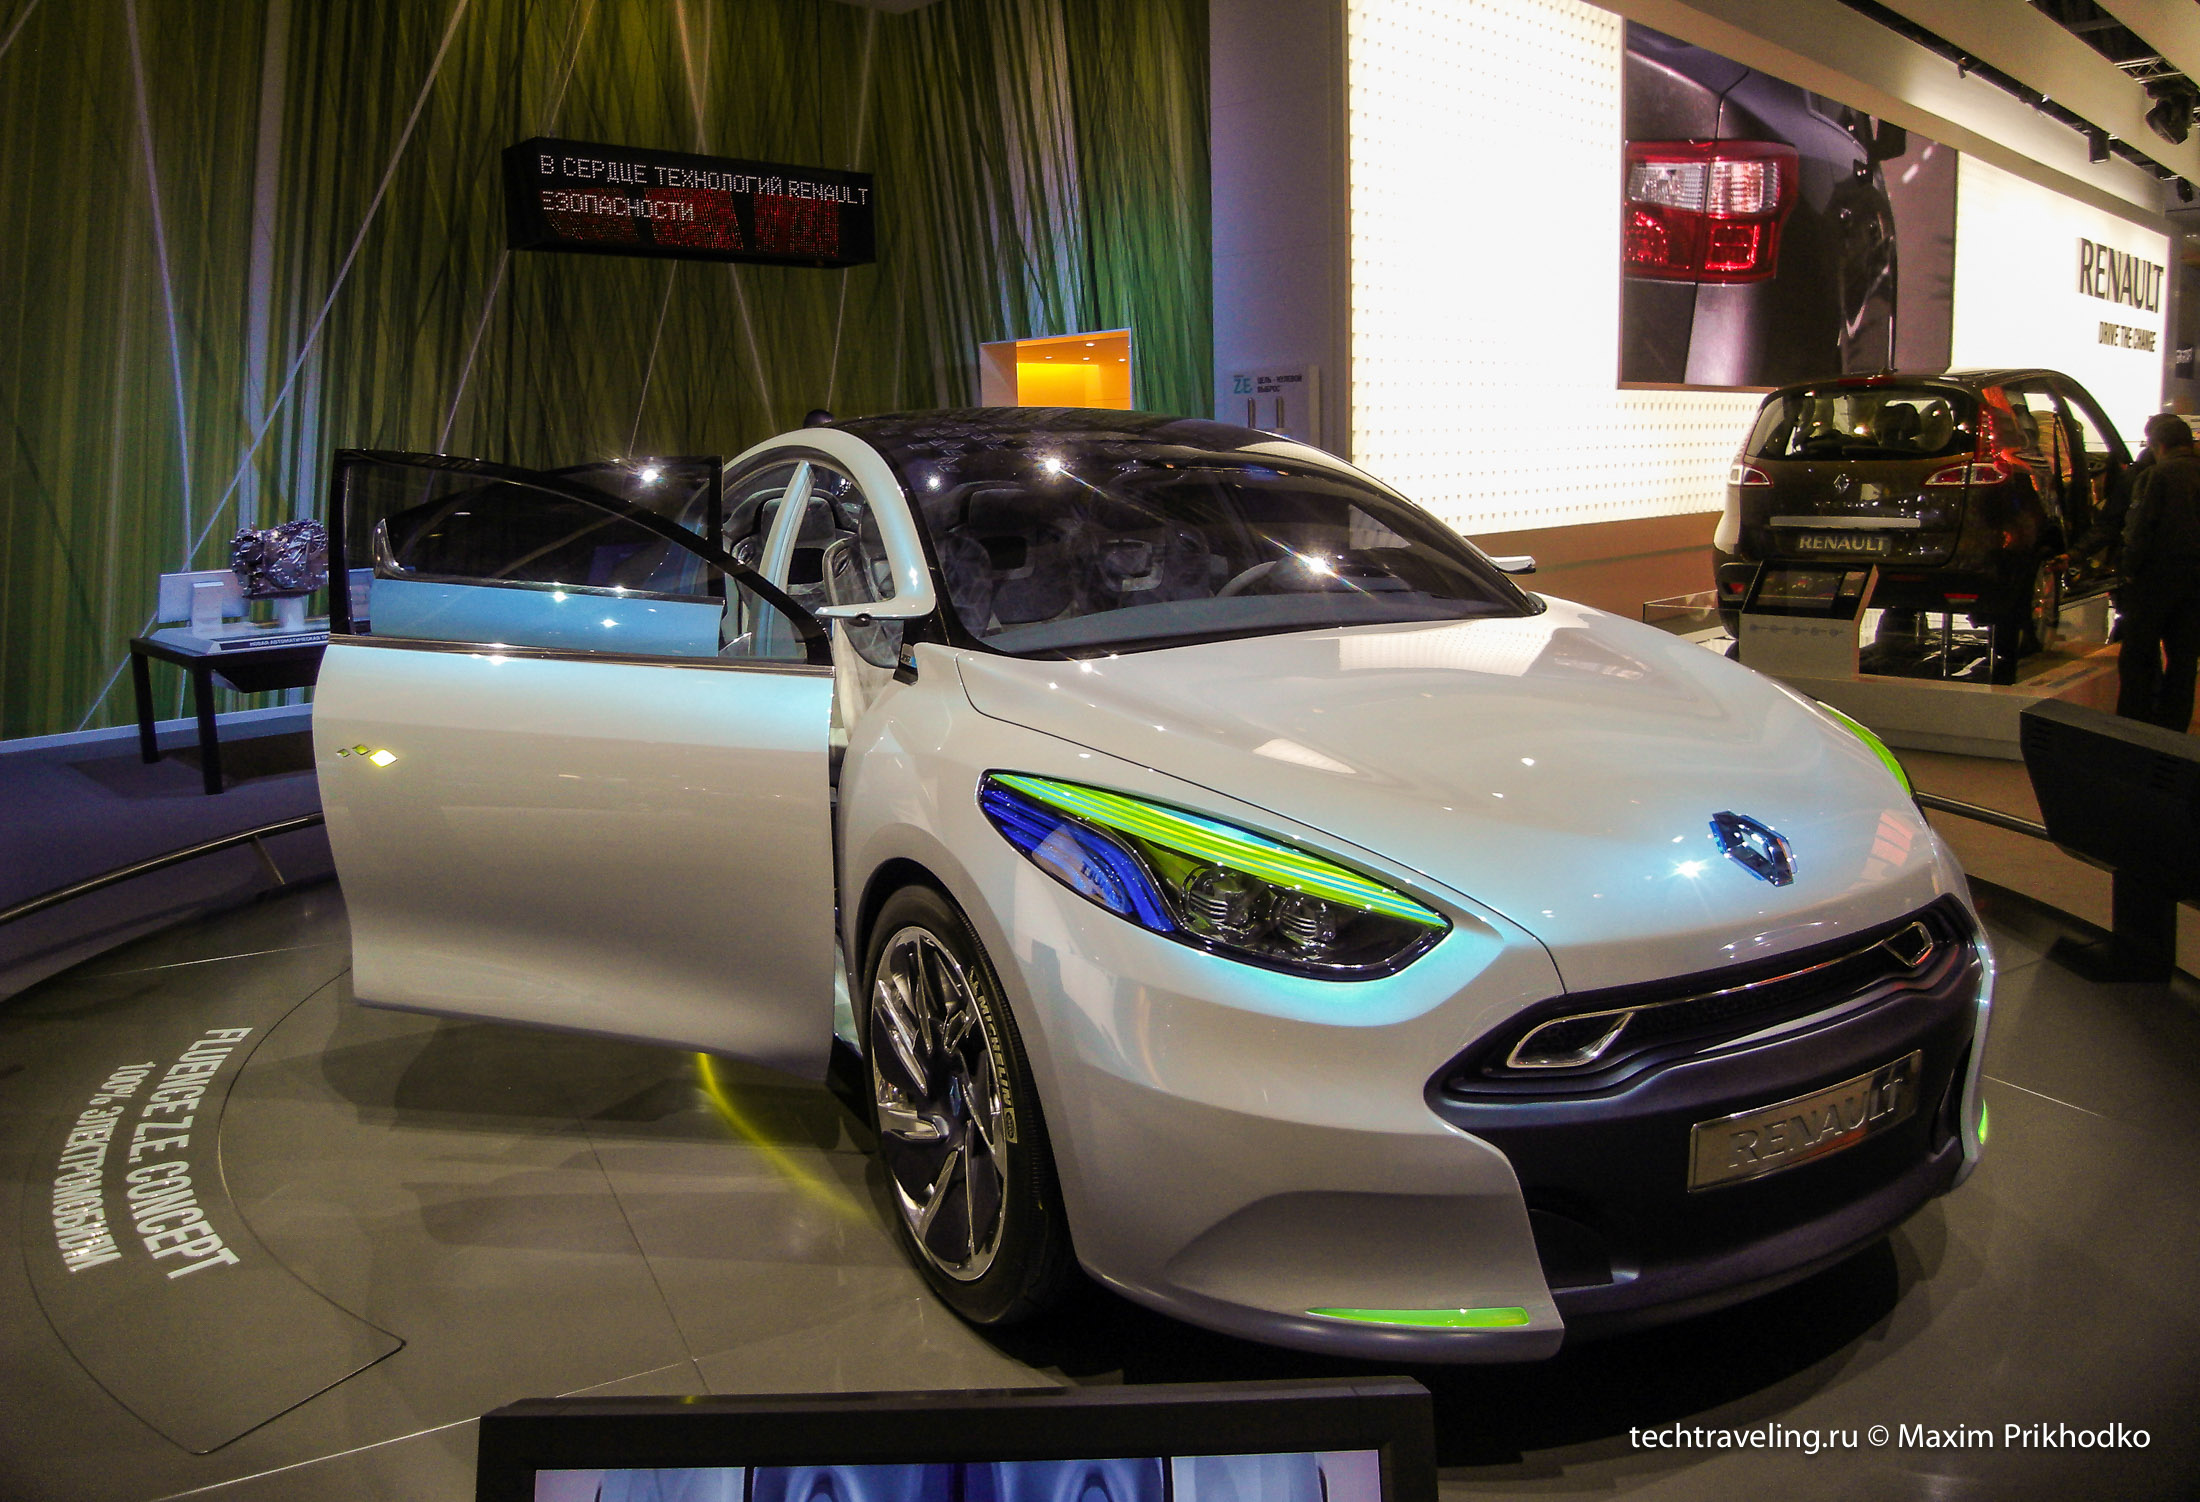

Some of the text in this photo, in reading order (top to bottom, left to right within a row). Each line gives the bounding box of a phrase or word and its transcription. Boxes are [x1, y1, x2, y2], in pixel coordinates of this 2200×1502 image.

[540, 154, 869, 206] В СЕРДЦЕ ТЕХНОЛОГИЙ RENAULT
[2078, 237, 2164, 313] RENAULT
[1799, 535, 1887, 551] RENAULT
[977, 995, 1014, 1107] MICHELIN
[52, 1061, 156, 1273] 100% ЭЛЕКТРОМОБИЛИ
[126, 1027, 253, 1279] FLUENCE Z.E. CONCEPT
[1727, 1076, 1904, 1168] RENAULT
